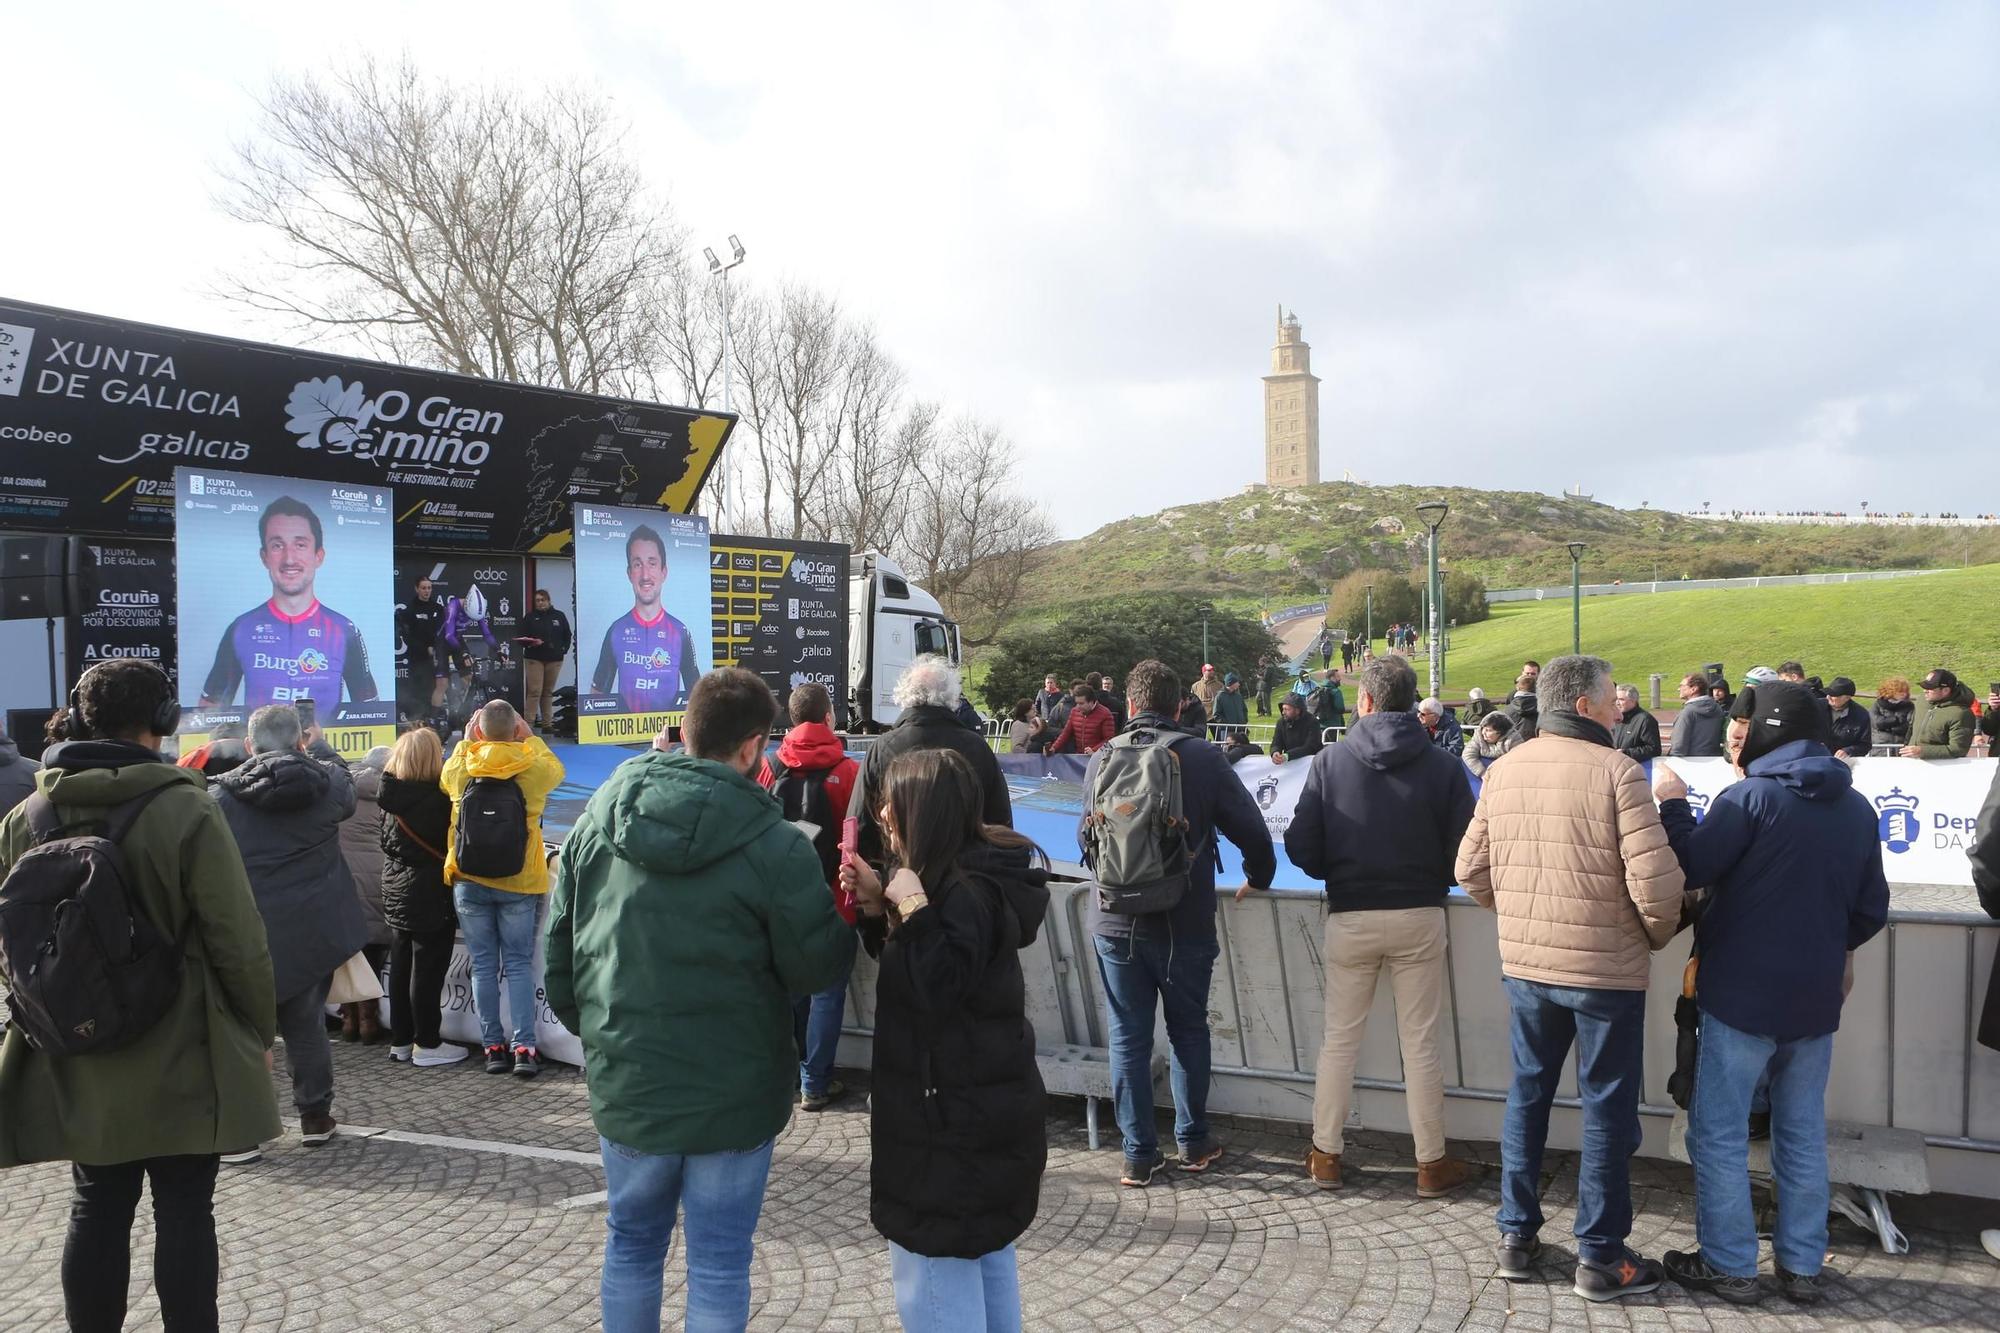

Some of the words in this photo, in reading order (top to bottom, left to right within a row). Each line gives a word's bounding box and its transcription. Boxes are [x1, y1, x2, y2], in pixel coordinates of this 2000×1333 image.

[45, 338, 177, 380] XUNTA
[37, 370, 90, 399] DE
[100, 380, 241, 418] GALICIA
[374, 390, 410, 422] O
[417, 396, 504, 435] Gran
[0, 425, 72, 445] cobeo
[98, 431, 250, 463] galicia
[206, 478, 236, 488] XUNTA
[386, 471, 403, 483] THE
[402, 473, 449, 486] HISTORICAL
[450, 478, 477, 489] ROUTE
[136, 479, 158, 495] 02
[206, 487, 218, 495] DE
[219, 487, 253, 497] GALICIA
[331, 488, 338, 497] A
[339, 489, 368, 500] Coruña
[423, 501, 441, 515] 04
[593, 511, 612, 519] XUNTA
[601, 519, 622, 527] GALICIA
[104, 548, 137, 557] XUNTA
[104, 556, 116, 565] DE
[118, 557, 156, 566] GALICIA
[816, 561, 836, 573] Gran
[100, 589, 159, 604] Coruña
[801, 600, 824, 609] XUNTA
[112, 608, 163, 617] PROVINCIA
[801, 610, 810, 618] DE
[811, 610, 838, 618] GALICIA
[83, 617, 103, 627] POR
[106, 617, 160, 627] DESCUBRIR
[84, 644, 96, 658] A
[101, 643, 160, 658] Coruña
[793, 644, 832, 663] galicia
[253, 648, 329, 676] Burgos
[624, 647, 671, 670] Burgos
[395, 668, 409, 678] UTE
[815, 672, 835, 683] Gran
[635, 678, 659, 690] BH
[272, 686, 310, 701] BH
[206, 715, 240, 724] CORTIZO
[597, 718, 634, 737] VICTOR
[636, 715, 684, 735] LANG
[1264, 815, 1288, 823] ación
[1934, 833, 1963, 849] DA
